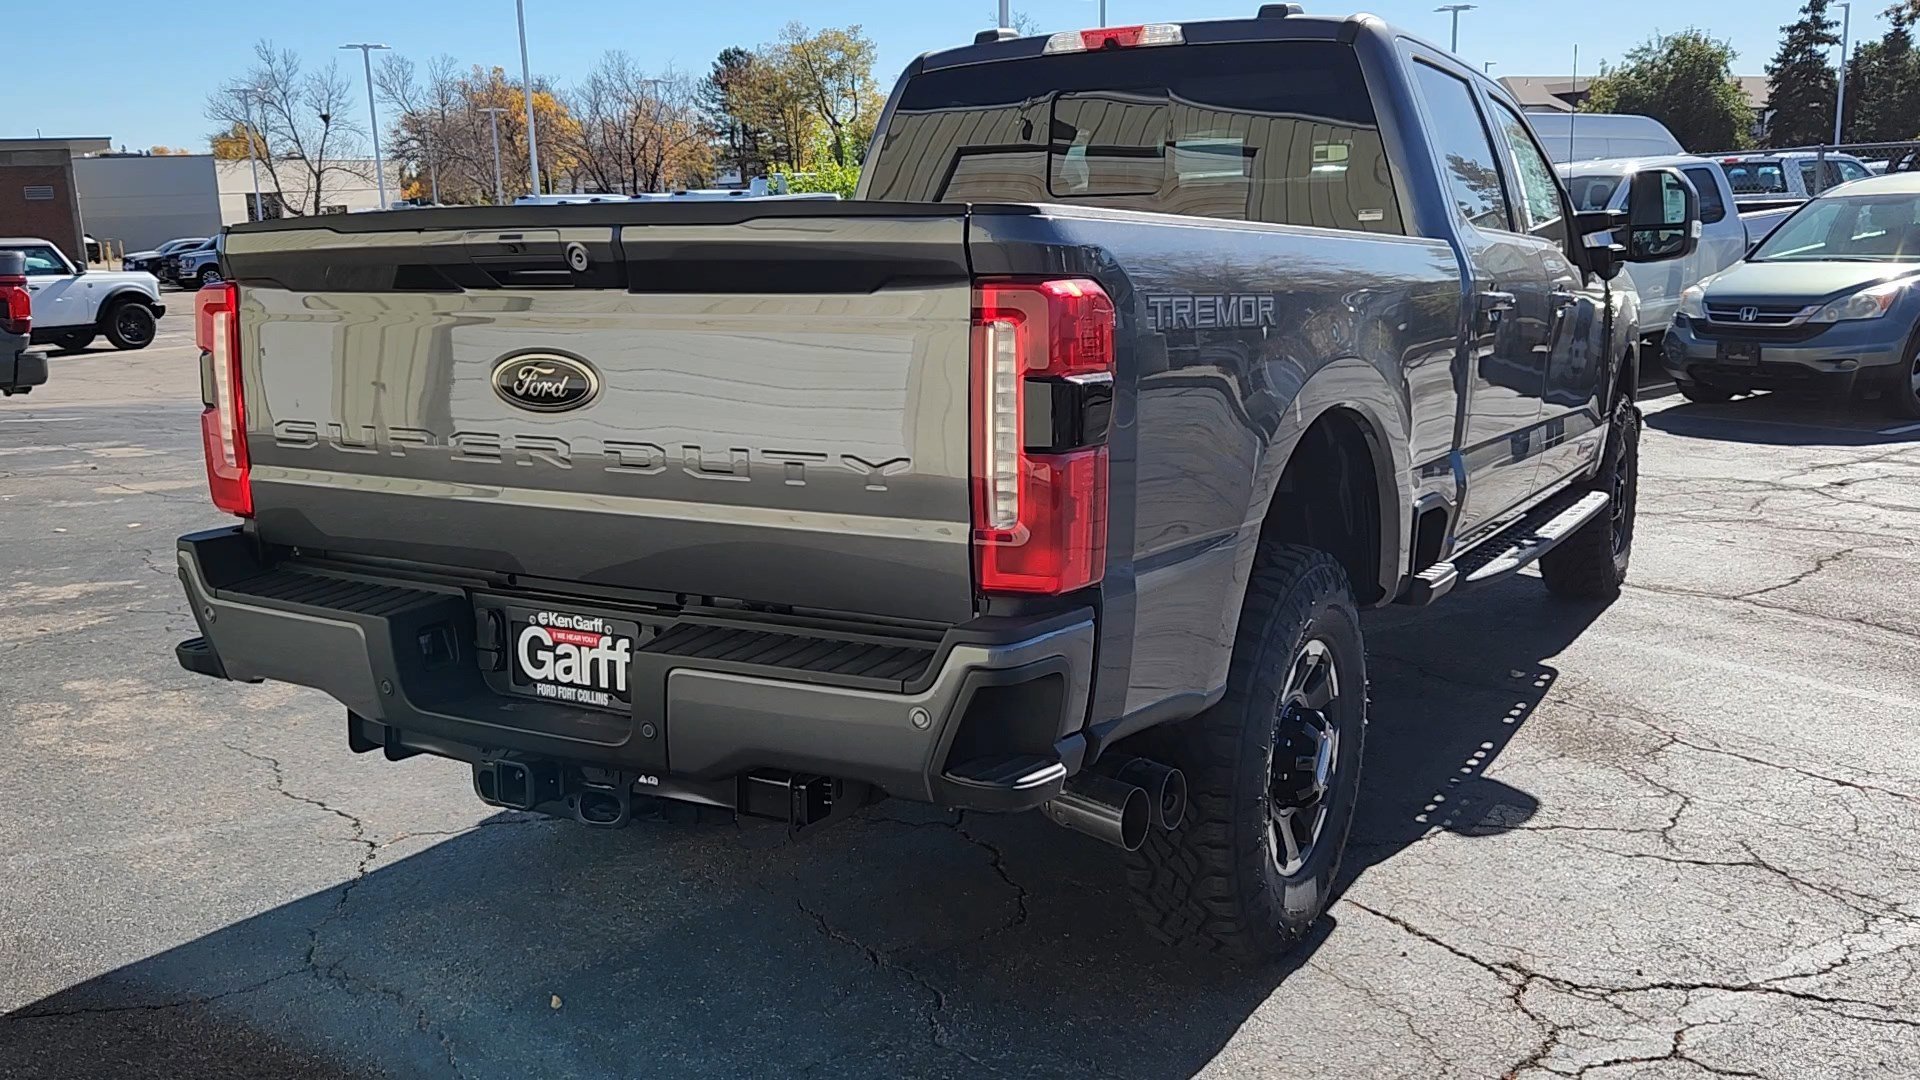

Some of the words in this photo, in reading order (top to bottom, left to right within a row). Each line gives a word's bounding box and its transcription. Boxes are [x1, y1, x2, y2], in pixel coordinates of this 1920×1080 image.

[1146, 294, 1276, 330] TREMOR
[513, 365, 569, 398] Ford
[273, 419, 572, 470] SUPER
[602, 440, 911, 491] DUTY
[556, 632, 566, 640] WE
[566, 633, 582, 642] HEAR
[518, 625, 631, 692] Garff
[536, 683, 557, 697] FORD
[557, 686, 577, 701] FORT
[577, 689, 609, 706] COLLINS
